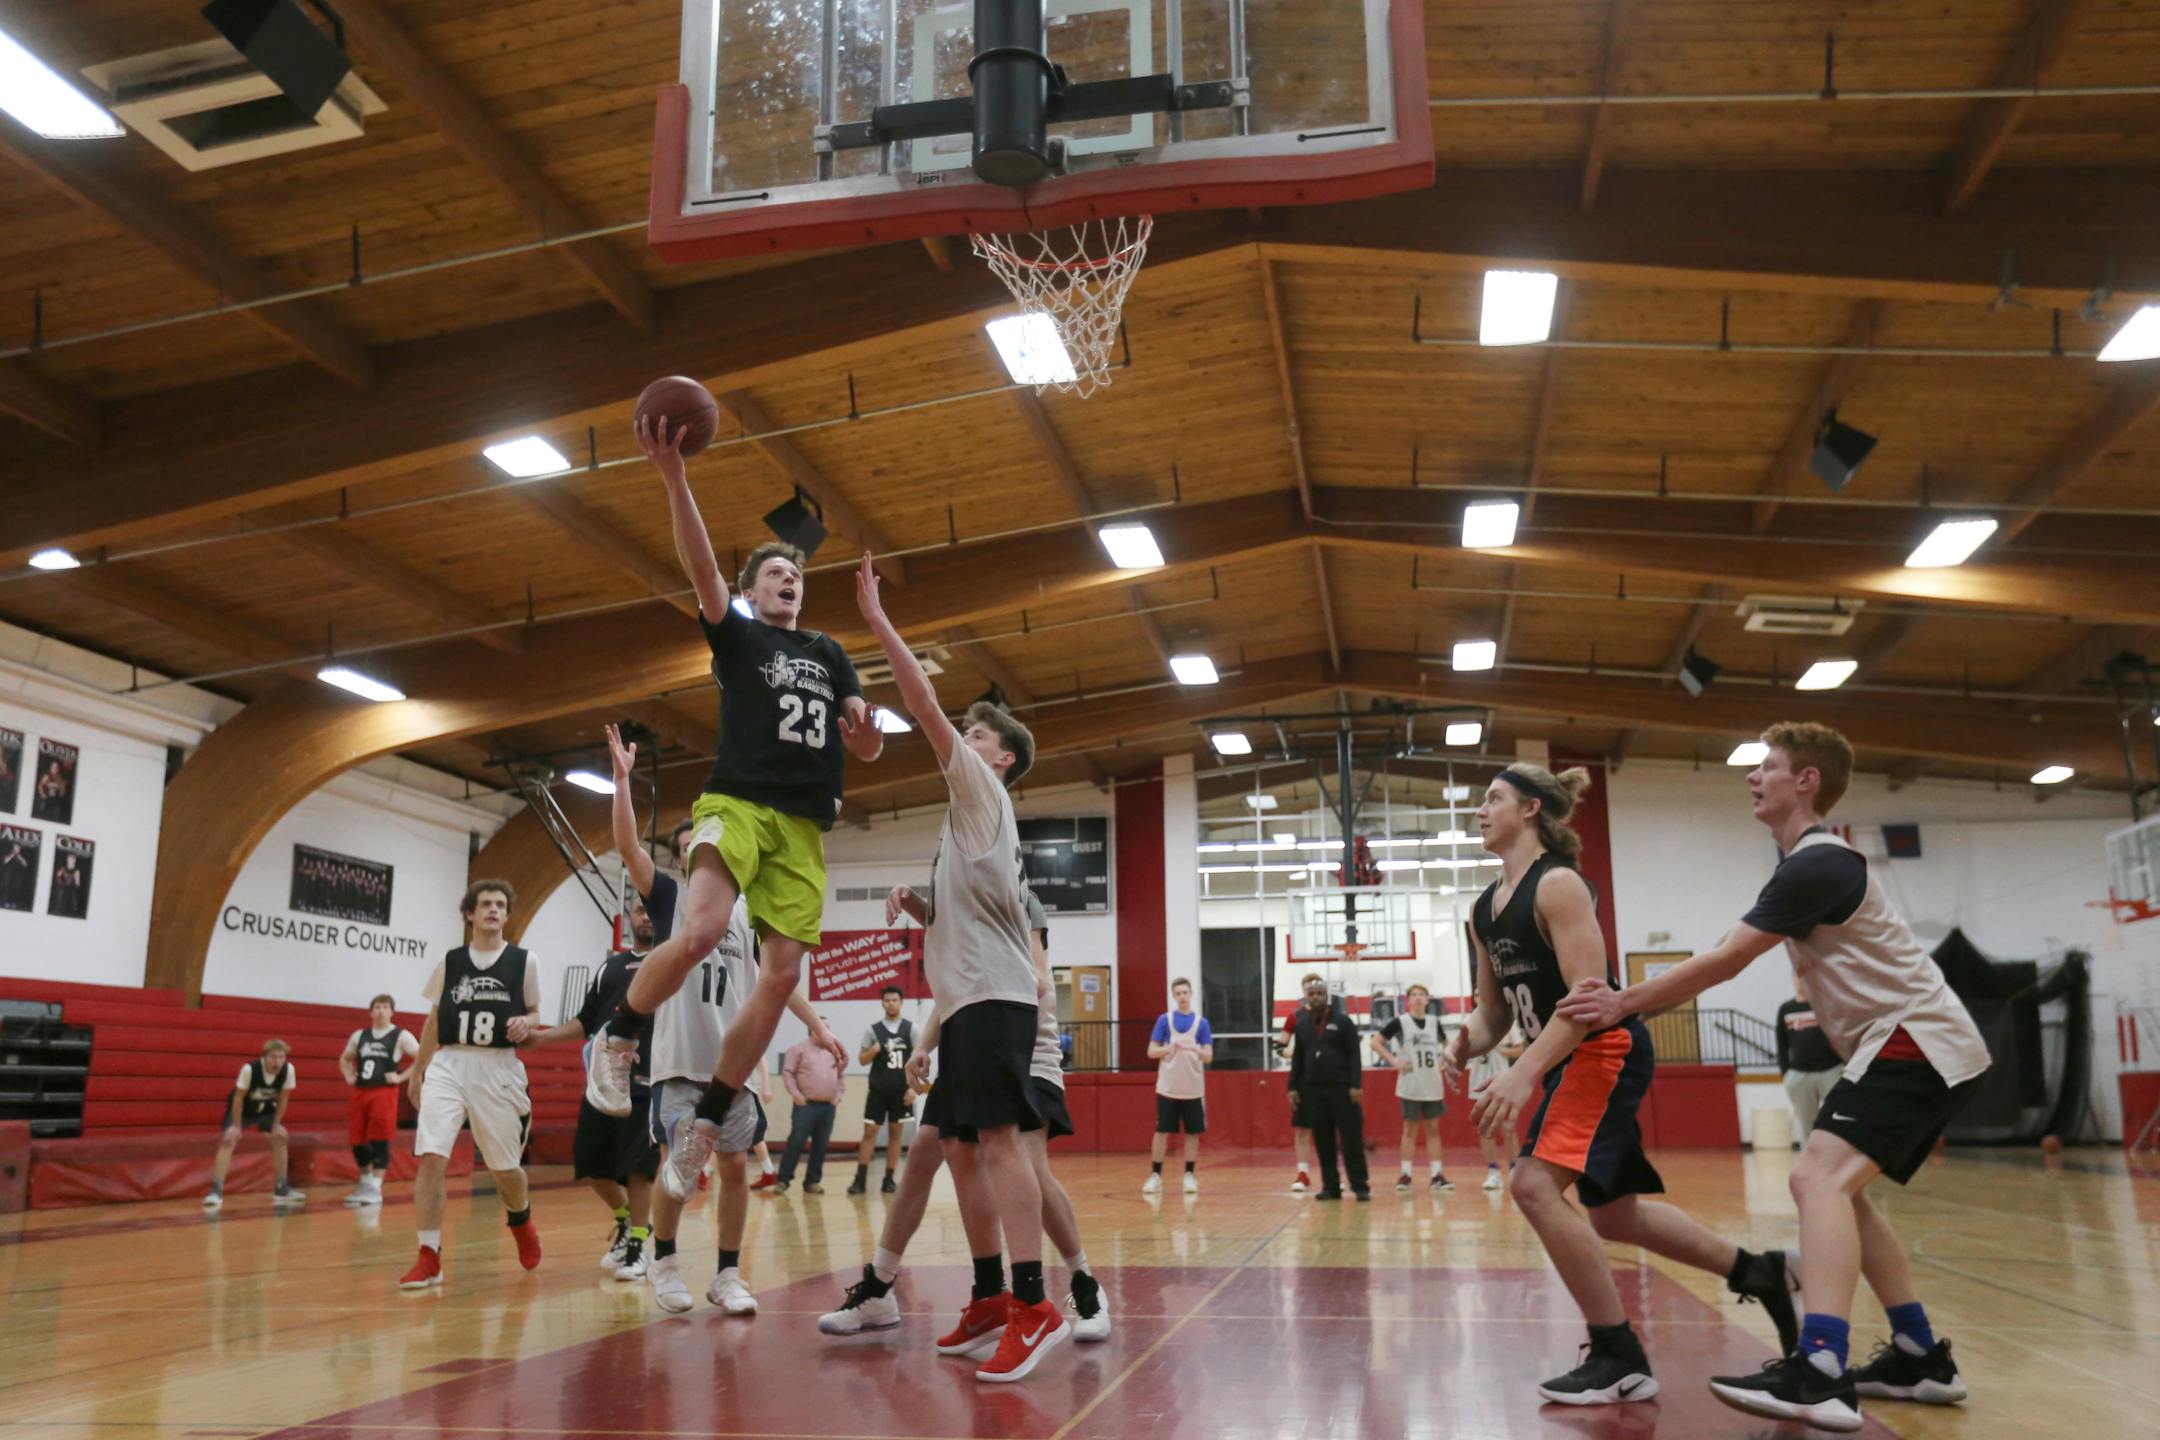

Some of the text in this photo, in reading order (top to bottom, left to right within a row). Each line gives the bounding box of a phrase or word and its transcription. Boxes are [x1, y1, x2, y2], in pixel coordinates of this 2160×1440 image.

[796, 680, 835, 702] BASKETBALL
[778, 693, 828, 750] 23
[223, 905, 339, 946] CRUSADER
[344, 925, 429, 959] COUNTRY
[843, 936, 877, 953] WAY
[825, 958, 858, 972] truth
[701, 961, 728, 1007] 11
[816, 978, 830, 988] No
[458, 1010, 496, 1046] 18
[361, 1059, 376, 1080] 9
[886, 1050, 904, 1070] 31
[1416, 1050, 1435, 1068] 16
